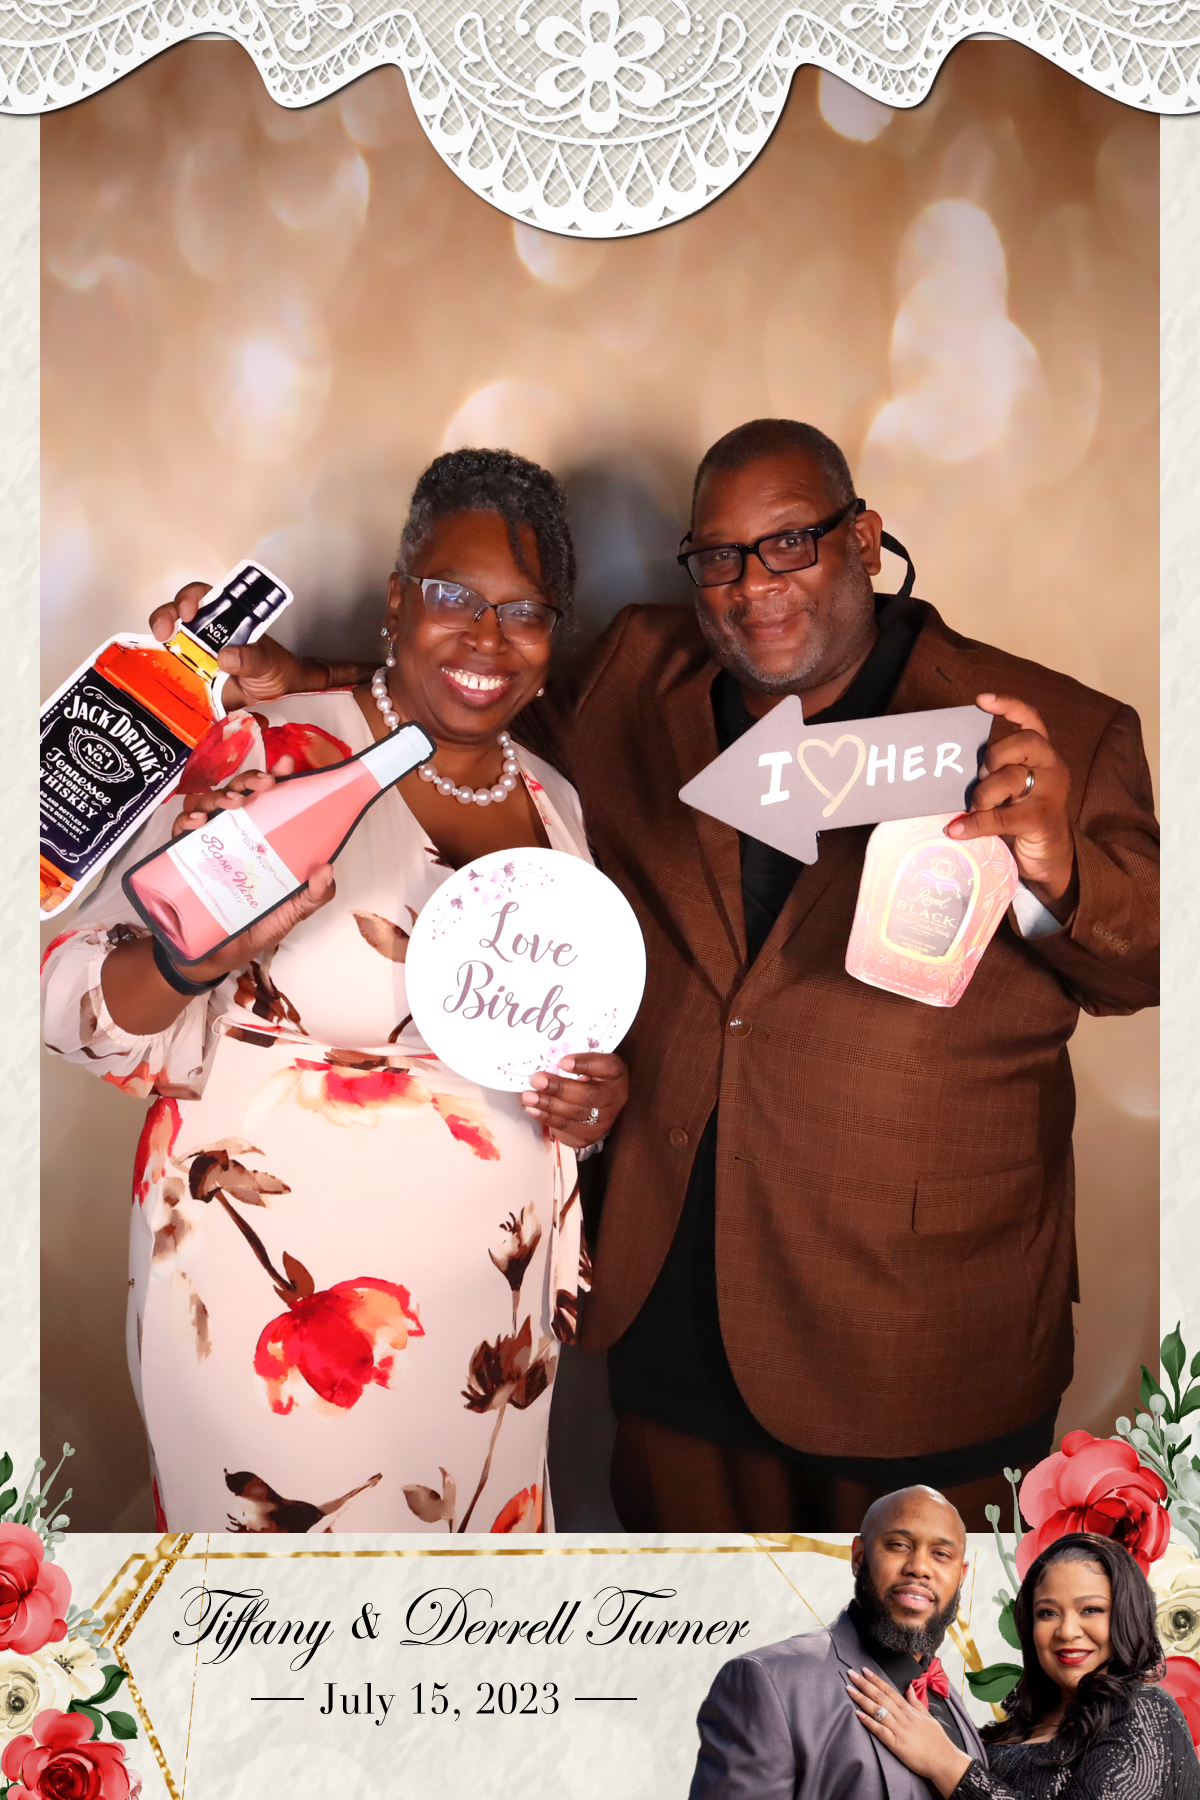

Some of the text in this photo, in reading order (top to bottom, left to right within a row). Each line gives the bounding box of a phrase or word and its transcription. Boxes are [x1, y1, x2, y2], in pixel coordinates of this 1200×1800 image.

[64, 695, 168, 783] JACK DRINK'S
[96, 744, 112, 758] Old
[46, 747, 111, 806] Tennessee
[53, 770, 90, 801] FAVORITE
[758, 742, 964, 806] I HER
[47, 798, 59, 807] AND
[58, 806, 82, 826] BOTTLED
[54, 810, 83, 835] DISTILLERY
[88, 842, 109, 865] QUALITY
[114, 794, 154, 837] CRAFTSMANSHIP
[201, 834, 258, 909] Rose Wine
[908, 886, 952, 909] Royal
[479, 901, 578, 966] Love
[896, 900, 956, 928] BLACK
[443, 960, 574, 1041] Birds
